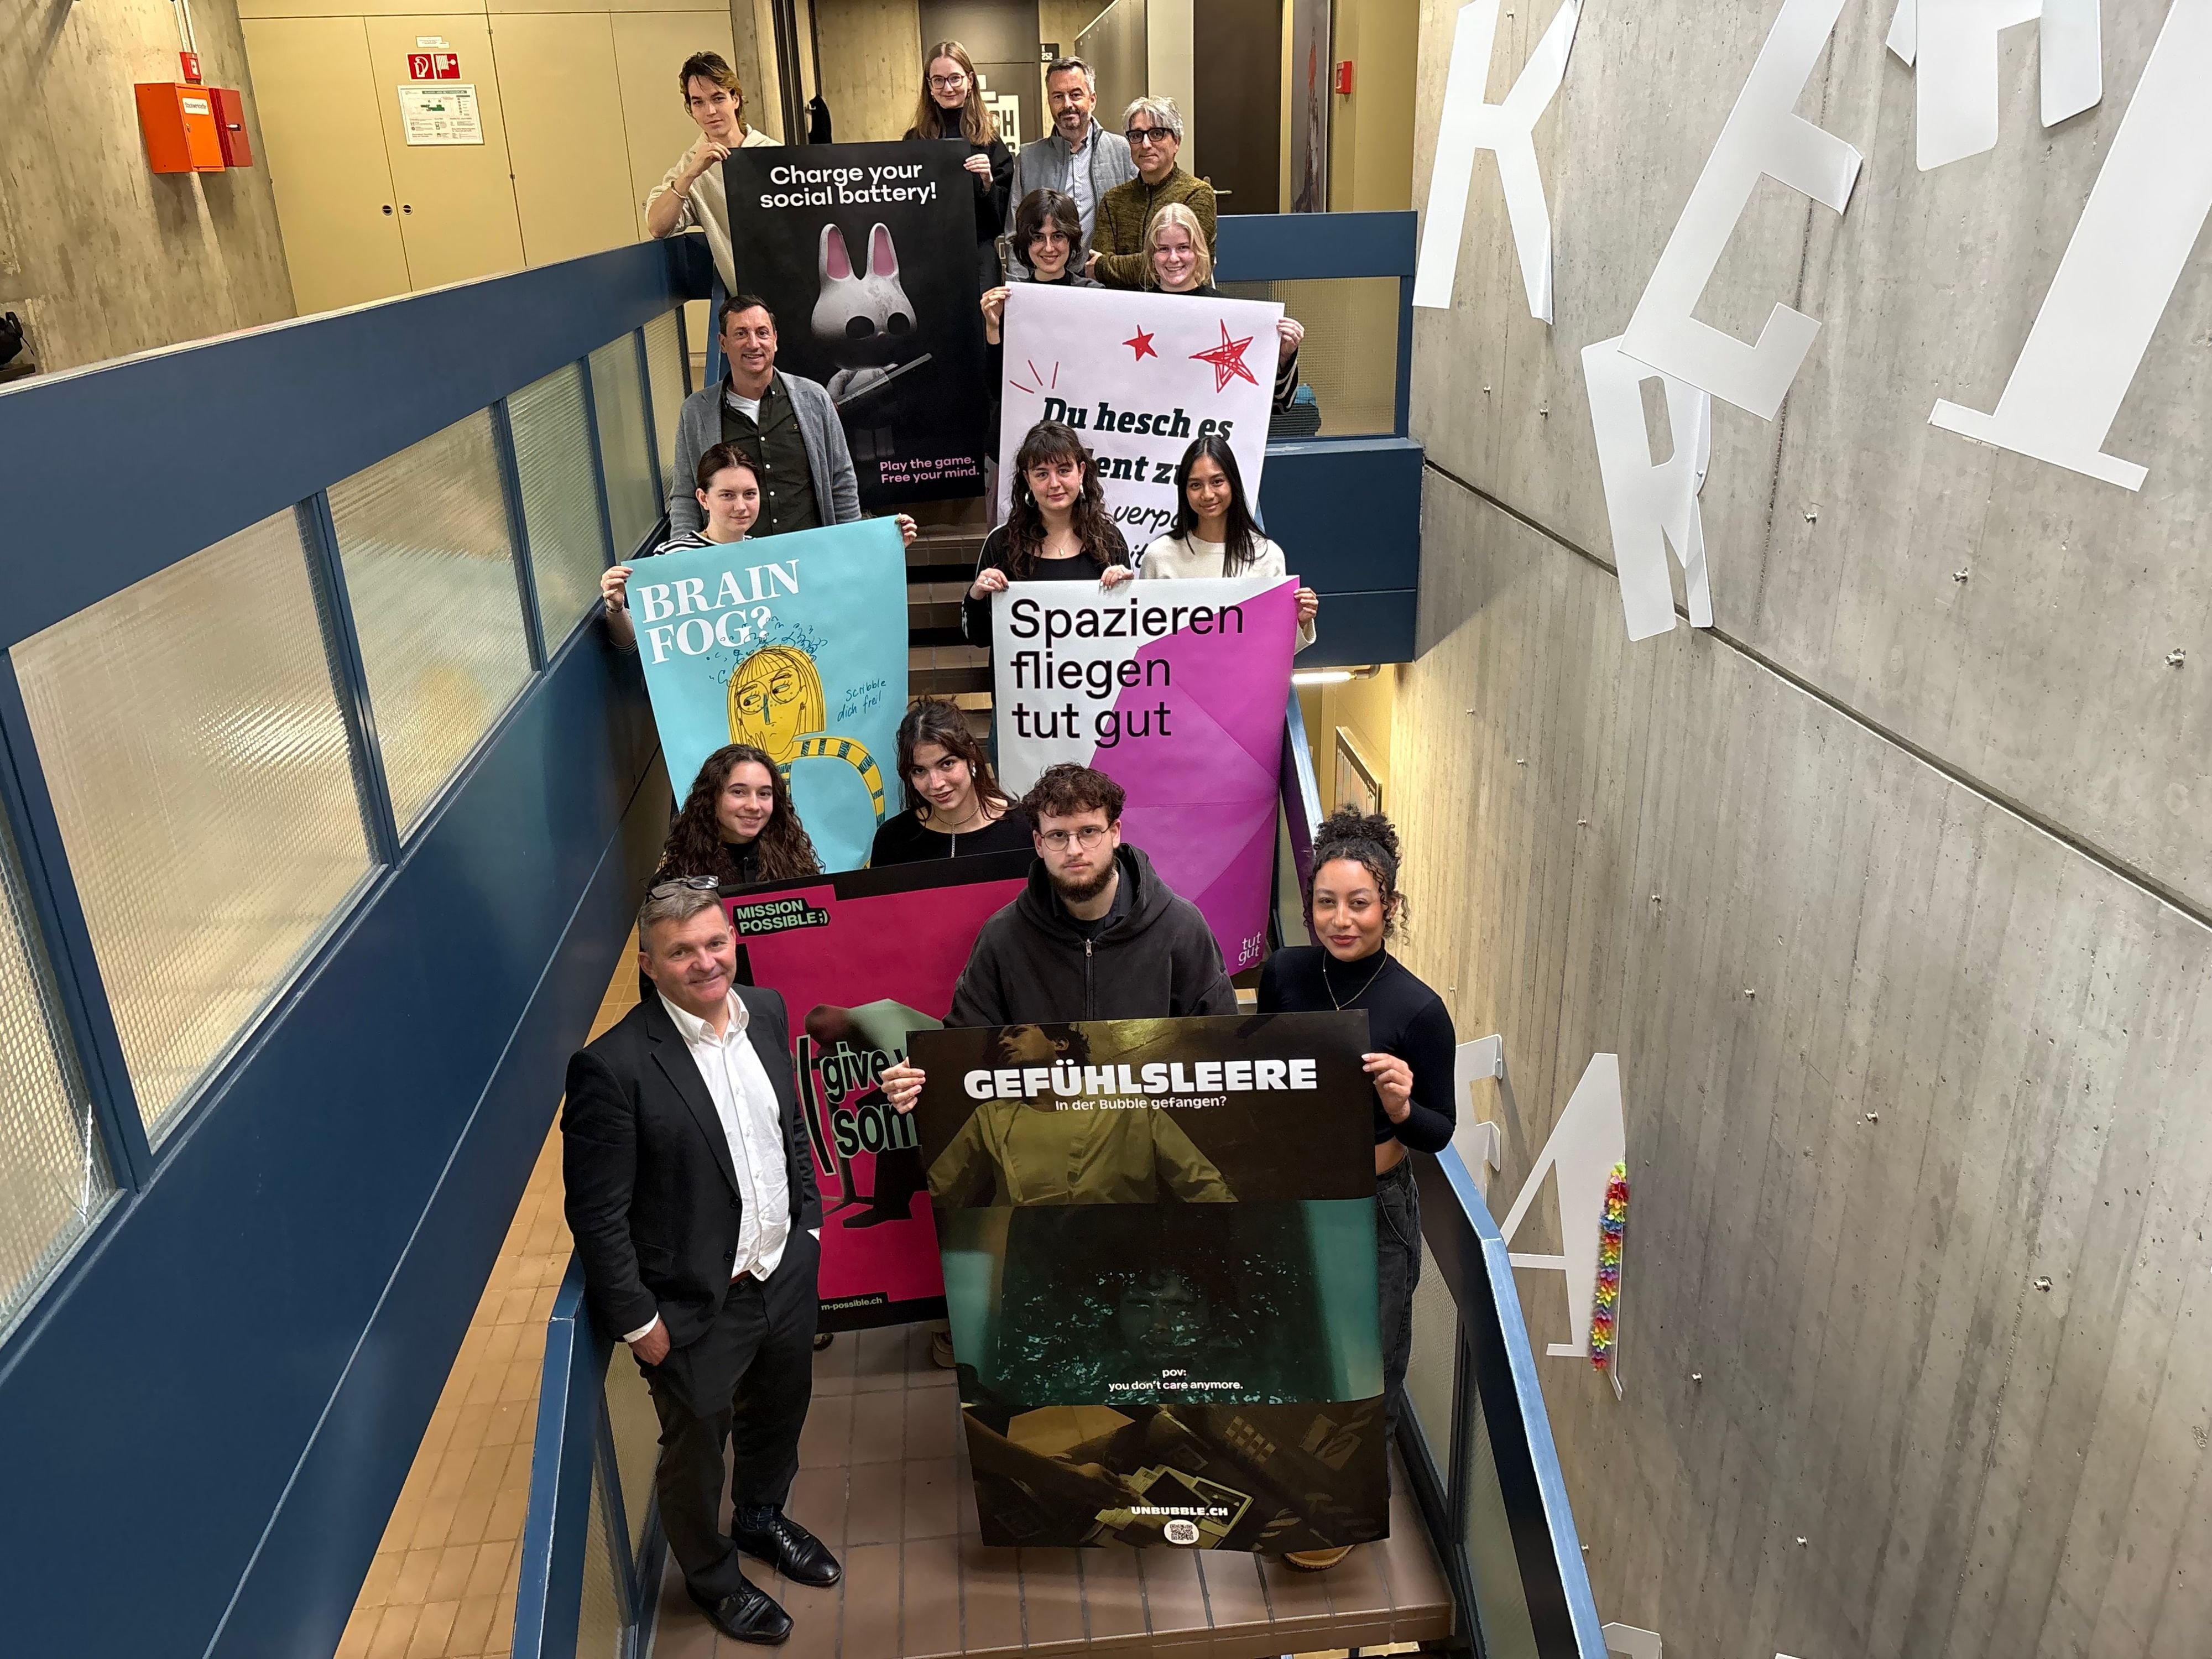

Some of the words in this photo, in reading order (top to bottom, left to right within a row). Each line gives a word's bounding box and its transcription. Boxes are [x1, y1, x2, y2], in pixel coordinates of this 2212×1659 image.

[1041, 52, 1053, 60] 252
[770, 165, 864, 187] Charge
[868, 164, 922, 185] your
[760, 187, 833, 208] social
[838, 182, 937, 205] battery!
[1040, 398, 1088, 428] Du
[1093, 402, 1191, 438] hesch
[1198, 419, 1234, 441] es
[880, 462, 907, 472] Play
[910, 458, 932, 469] the
[935, 456, 975, 469] game.
[881, 473, 910, 484] Free
[912, 471, 942, 483] your
[945, 466, 979, 477] mind.
[636, 559, 800, 624] BRAIN
[1009, 598, 1244, 649] Spazieren
[645, 605, 772, 665] FOG?
[1010, 648, 1171, 699] fliegen
[837, 703, 857, 722] dich
[863, 690, 881, 714] frei!
[1011, 703, 1080, 739] tut
[1094, 701, 1172, 749] gut
[737, 900, 804, 920] MISSION
[739, 912, 817, 933] POSSIBLE
[1242, 931, 1261, 951] tut
[1238, 946, 1260, 967] gut
[822, 1042, 890, 1103] give
[963, 1058, 1318, 1099] GEFÜHLSLEERE
[1055, 1100, 1069, 1110] In
[1072, 1099, 1096, 1110] der
[1099, 1098, 1147, 1110] Bubble
[1151, 1095, 1227, 1110] gefangen?
[1162, 1369, 1187, 1378] pov:
[1108, 1383, 1129, 1392] you
[1131, 1380, 1161, 1390] don't
[1190, 1381, 1244, 1391] anymore.
[1131, 1506, 1229, 1516] UNBUBBLE.CH
